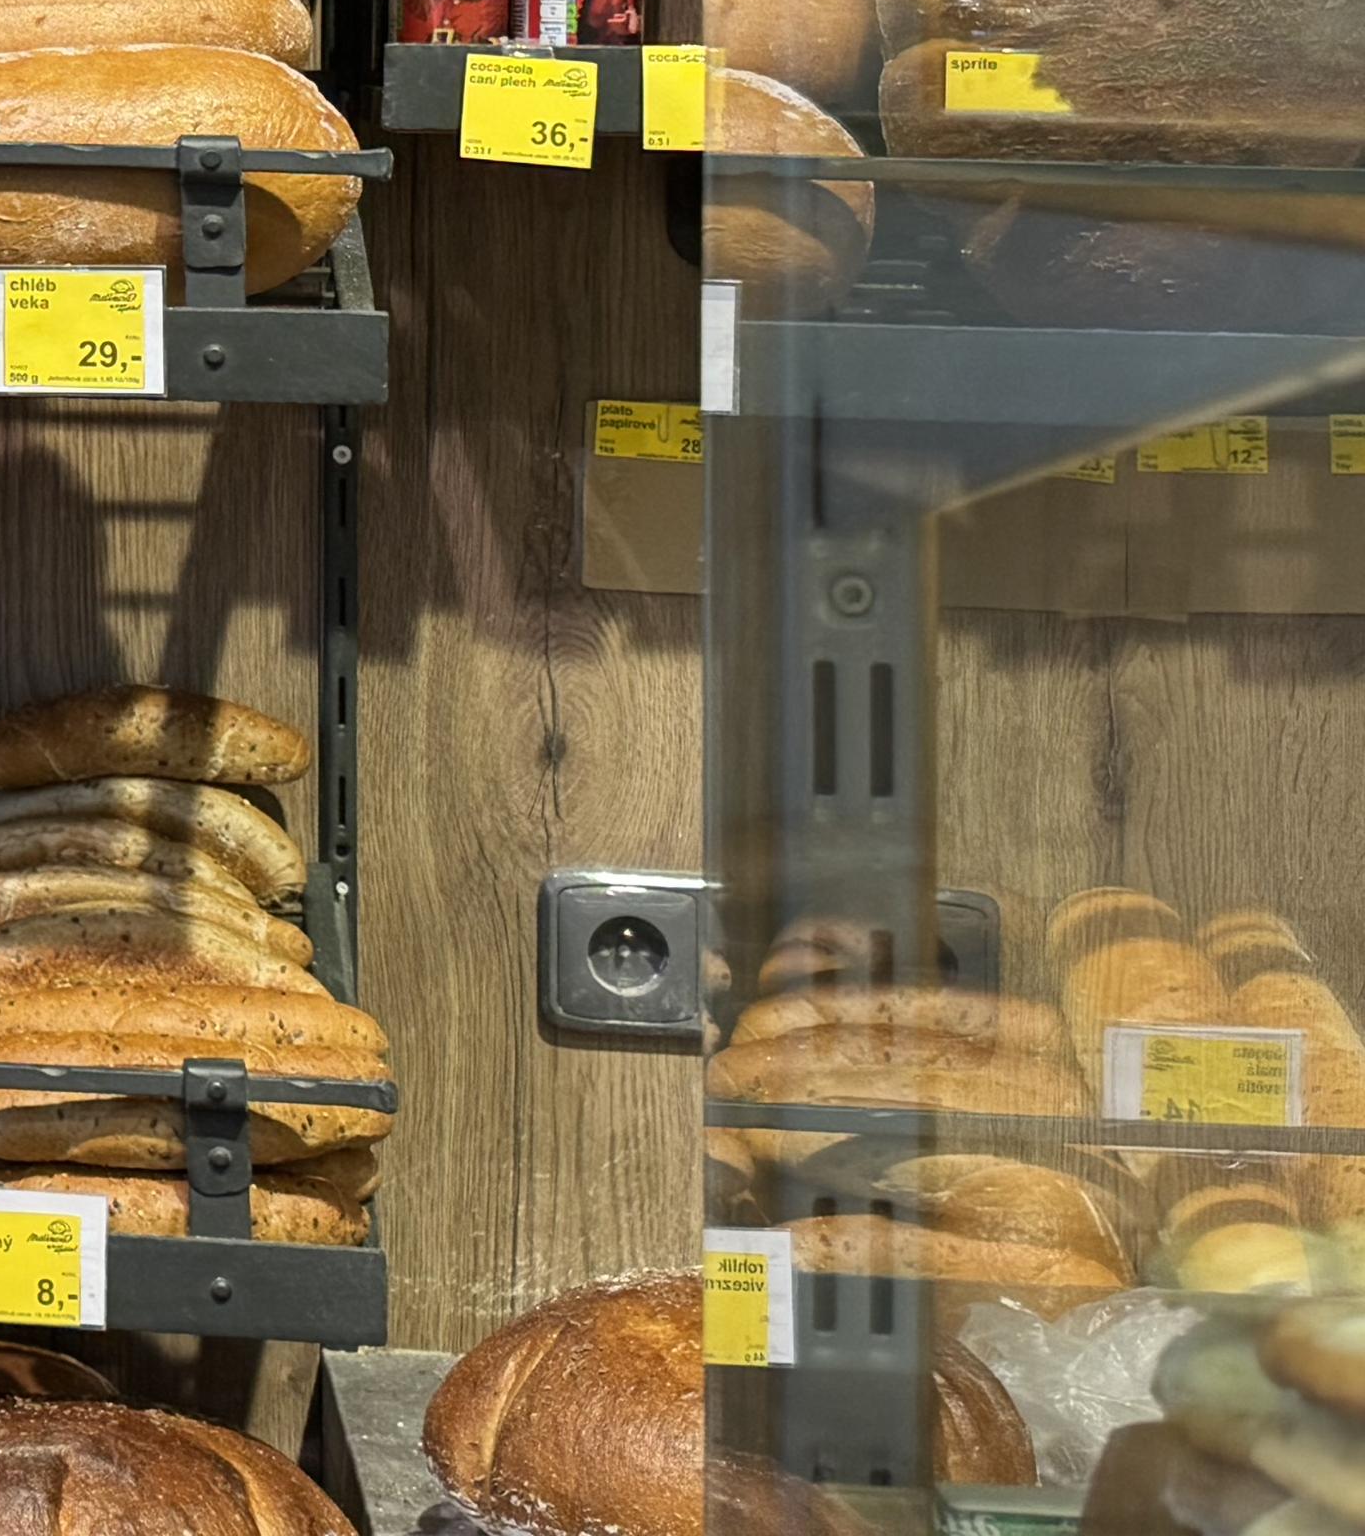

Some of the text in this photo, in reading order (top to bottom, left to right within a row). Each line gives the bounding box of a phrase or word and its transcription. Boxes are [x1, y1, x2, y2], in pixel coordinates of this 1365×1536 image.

[470, 62, 534, 75] coca-cola
[950, 56, 998, 72] sprite
[500, 75, 536, 89] plech
[530, 120, 589, 152] 36,-
[10, 277, 57, 293] chléb
[10, 295, 49, 310] veka
[78, 340, 142, 373] 29,-
[36, 1278, 78, 1311] 8,-
